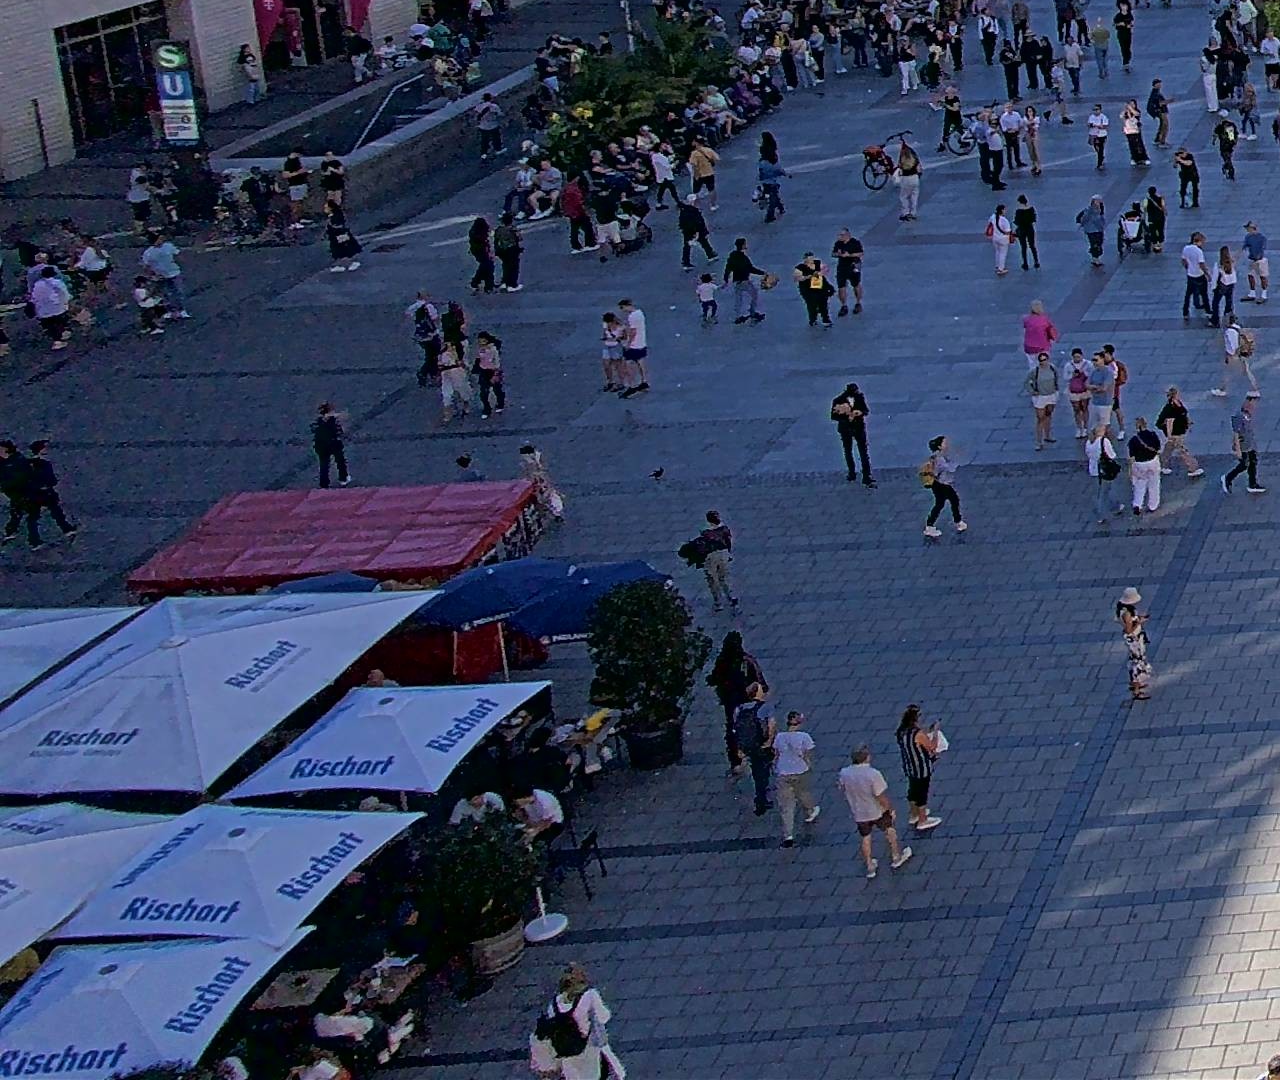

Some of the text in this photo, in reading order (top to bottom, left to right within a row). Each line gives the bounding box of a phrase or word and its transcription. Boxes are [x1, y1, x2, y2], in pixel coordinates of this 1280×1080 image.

[158, 45, 184, 68] S
[163, 74, 185, 96] U
[225, 640, 297, 689] Rischart
[37, 727, 140, 747] Rischart
[425, 696, 499, 753] Rischart
[289, 755, 396, 779] Rischart
[276, 831, 364, 901] Rischart
[119, 897, 240, 923] Rischart
[163, 956, 251, 1034] Rischart
[0, 1042, 127, 1077] Rischart
